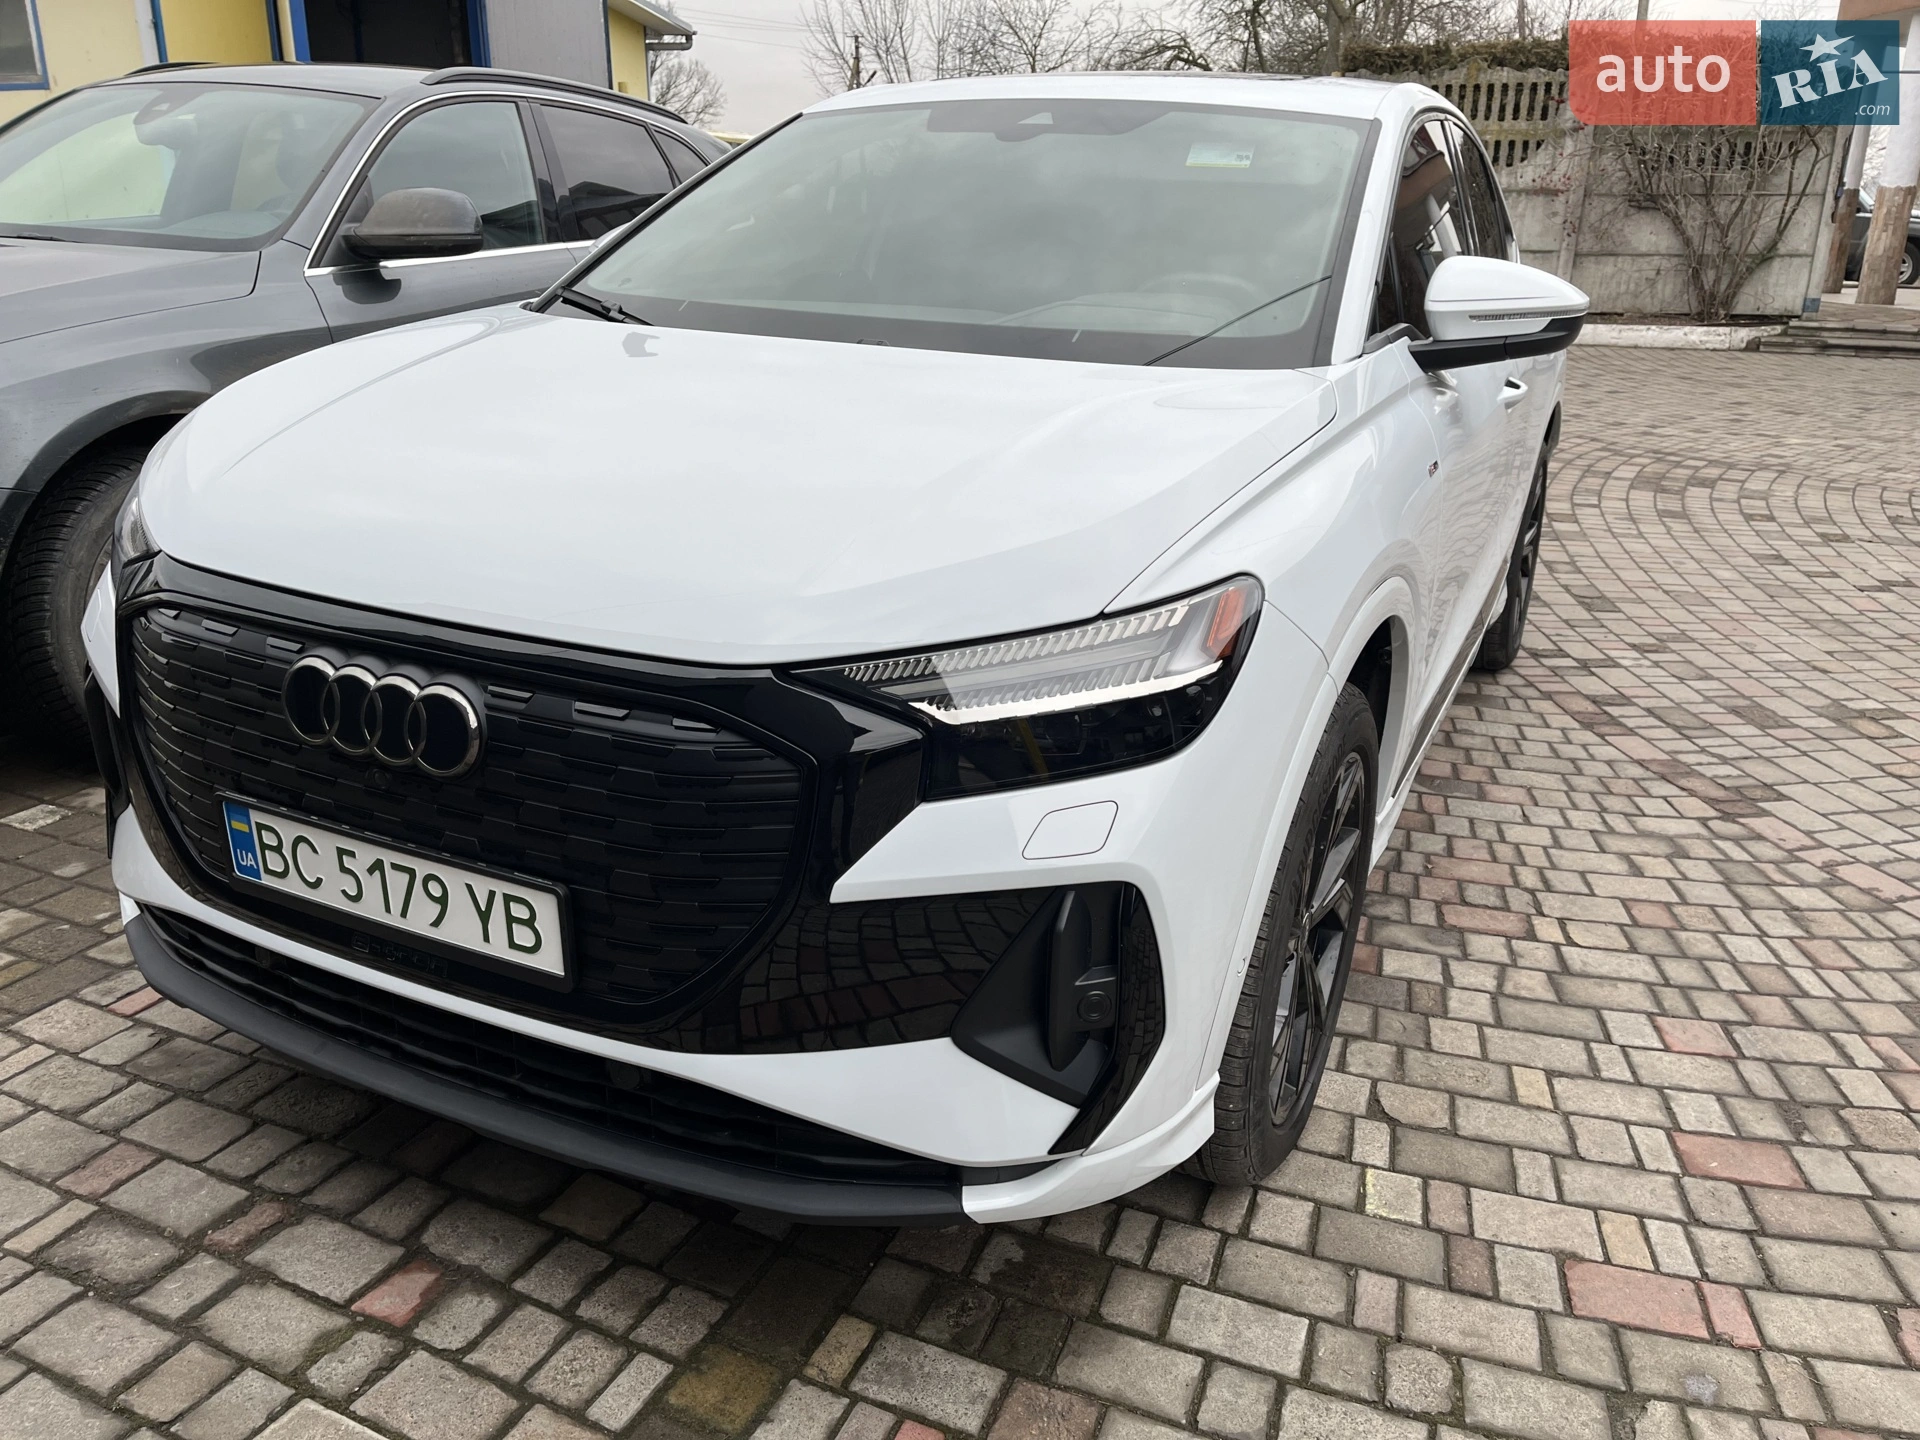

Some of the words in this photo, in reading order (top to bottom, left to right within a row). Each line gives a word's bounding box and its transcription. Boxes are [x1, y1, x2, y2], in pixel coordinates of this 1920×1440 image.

[236, 848, 258, 870] UA
[254, 821, 324, 890] BC
[335, 845, 450, 929] 5179
[464, 882, 543, 954] YB
